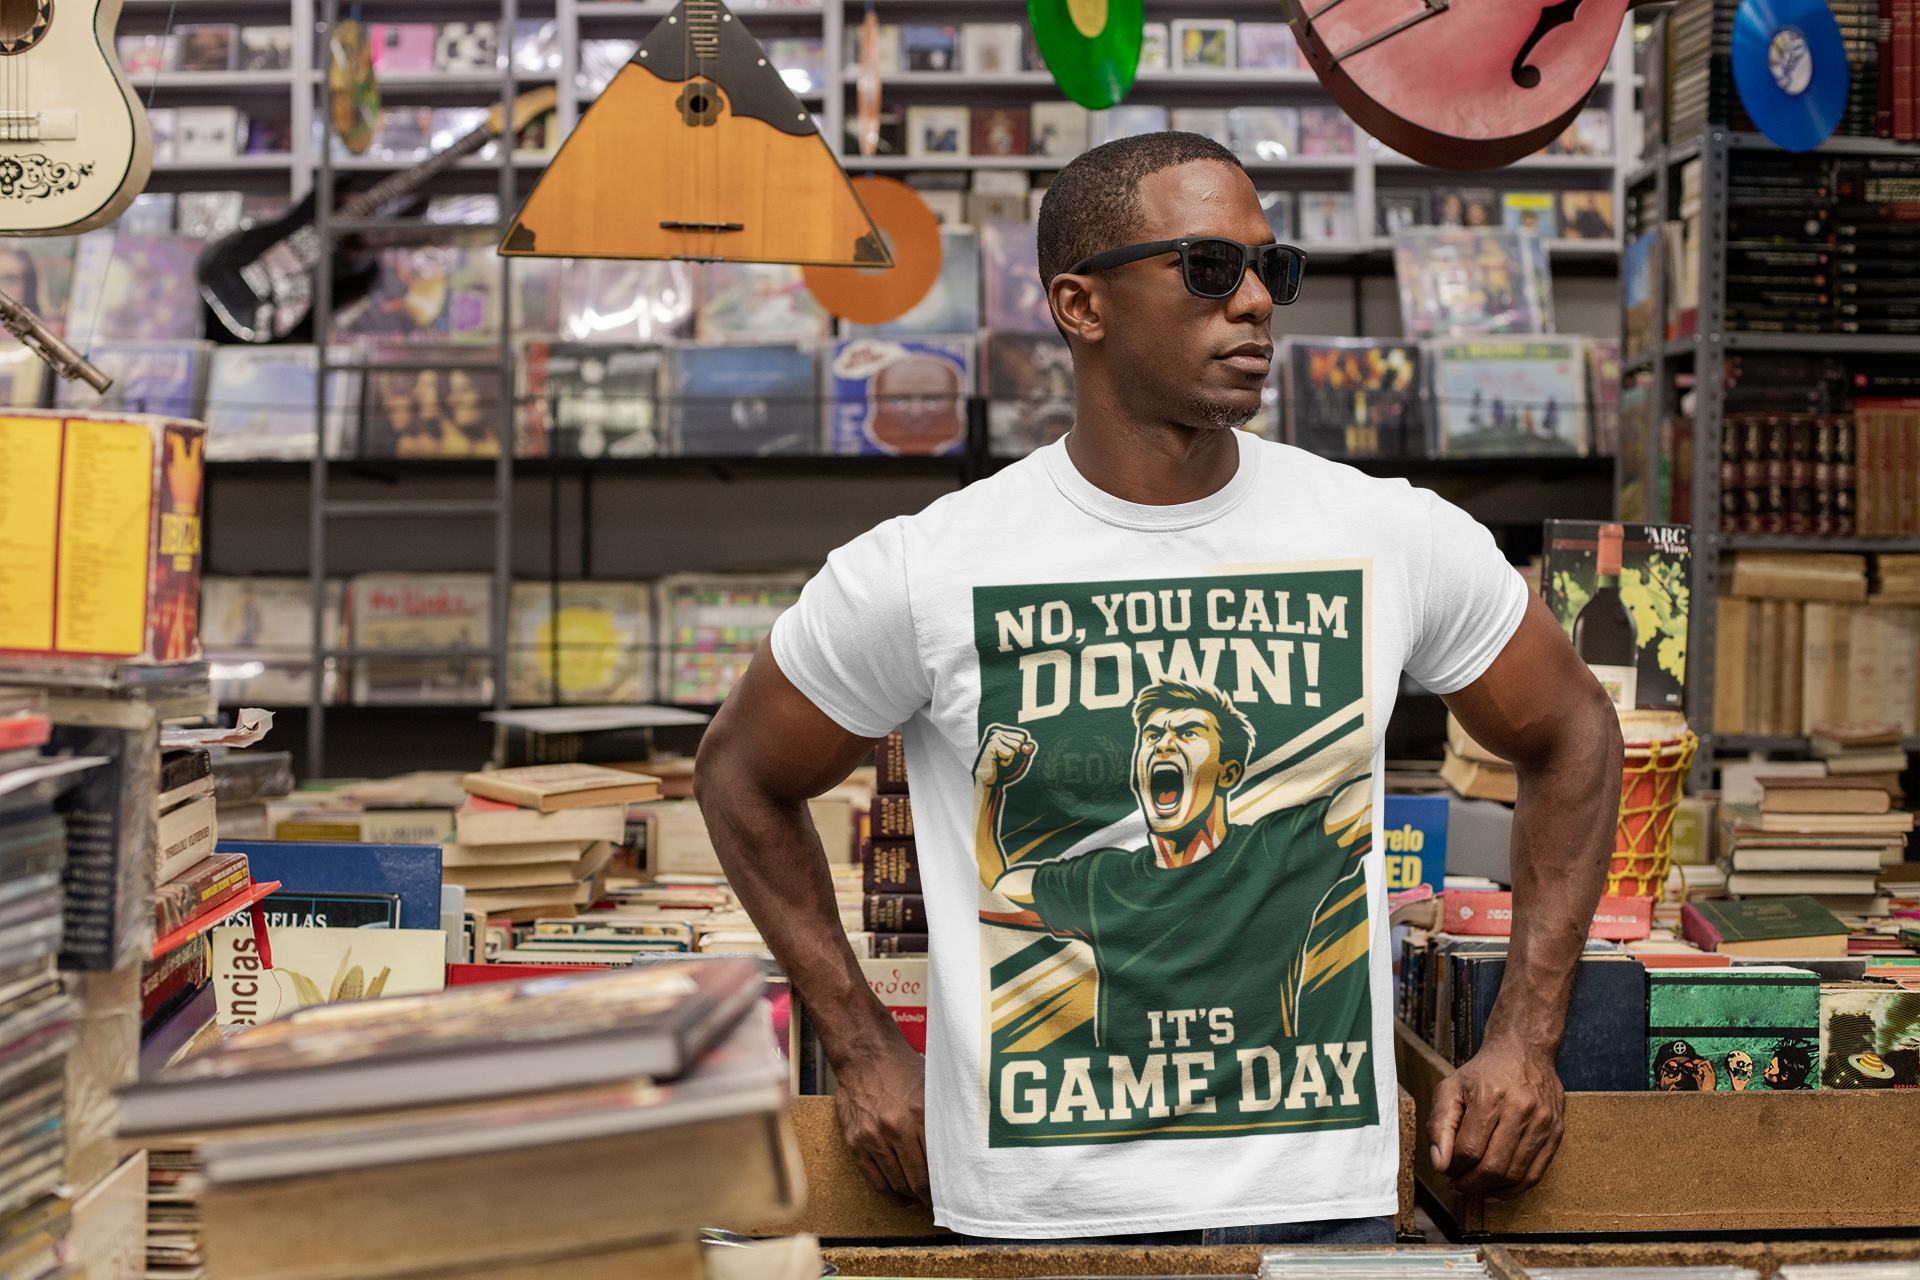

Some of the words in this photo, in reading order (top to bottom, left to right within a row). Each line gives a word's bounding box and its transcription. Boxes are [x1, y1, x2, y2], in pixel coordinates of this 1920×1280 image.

[1647, 527, 1686, 544] ABC
[995, 600, 1086, 653] NO,
[1091, 589, 1192, 636] YOU
[1206, 588, 1349, 639] CALM
[1017, 637, 1322, 724] DOWN!
[1384, 823, 1424, 852] relo
[1147, 1006, 1235, 1048] IT'S
[1000, 1051, 1217, 1125] GAME
[1236, 1040, 1368, 1113] DAY
